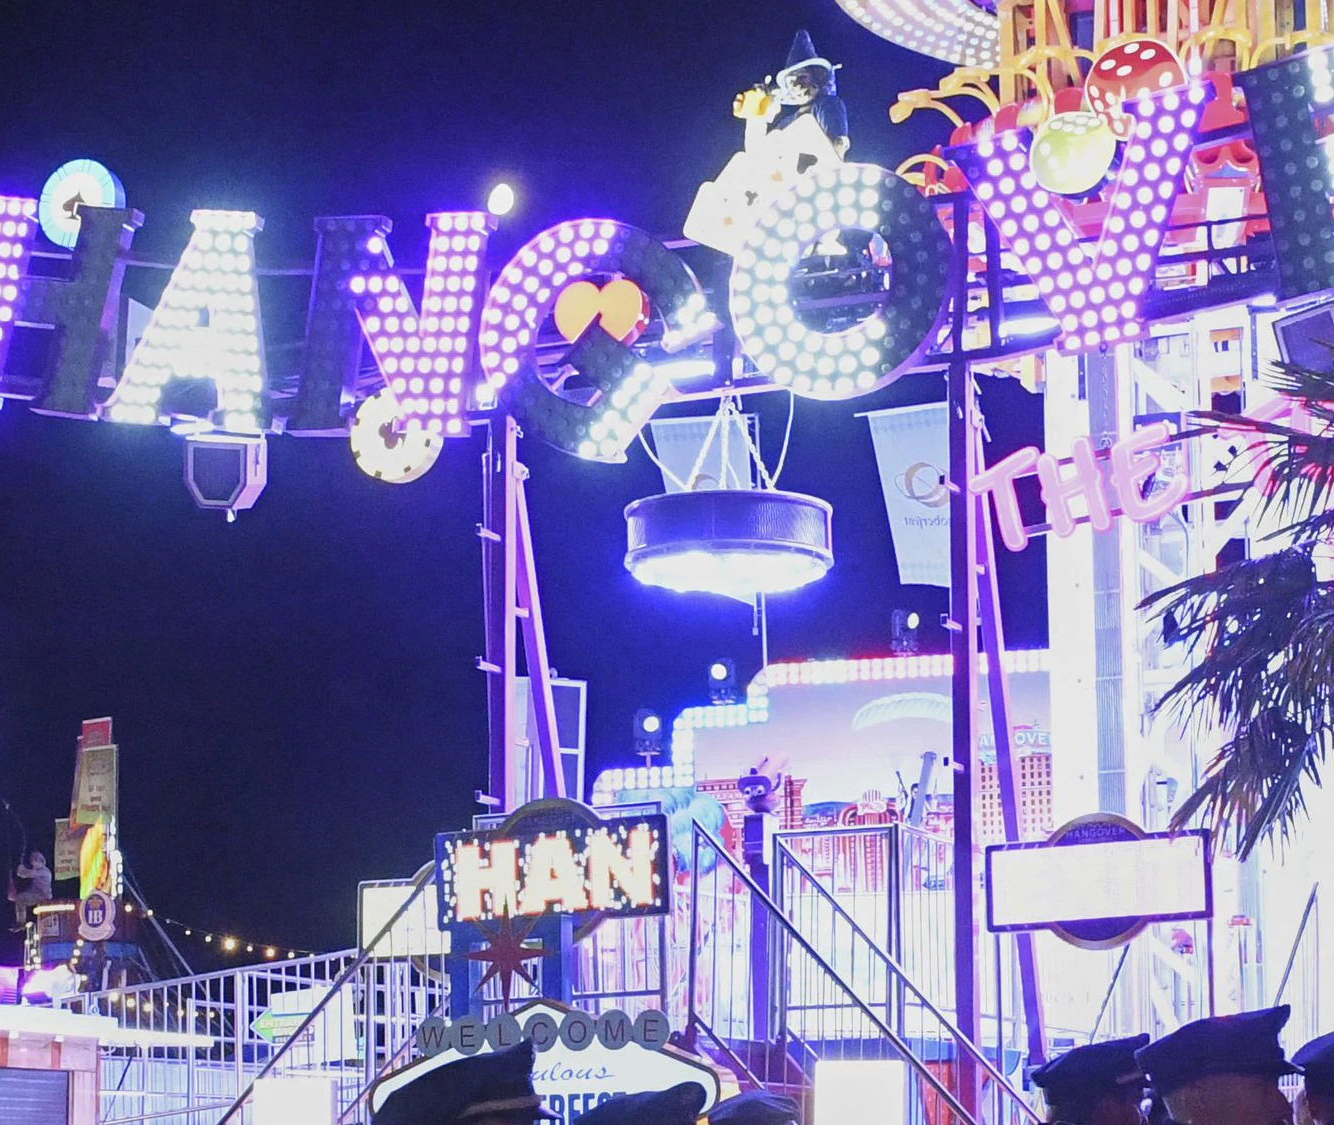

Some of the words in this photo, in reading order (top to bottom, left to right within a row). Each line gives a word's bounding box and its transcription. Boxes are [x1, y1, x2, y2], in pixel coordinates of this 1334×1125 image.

[967, 420, 1189, 552] THE
[455, 827, 655, 922] HAN
[421, 1017, 660, 1049] WELCOME
[532, 1061, 616, 1081] ulous
